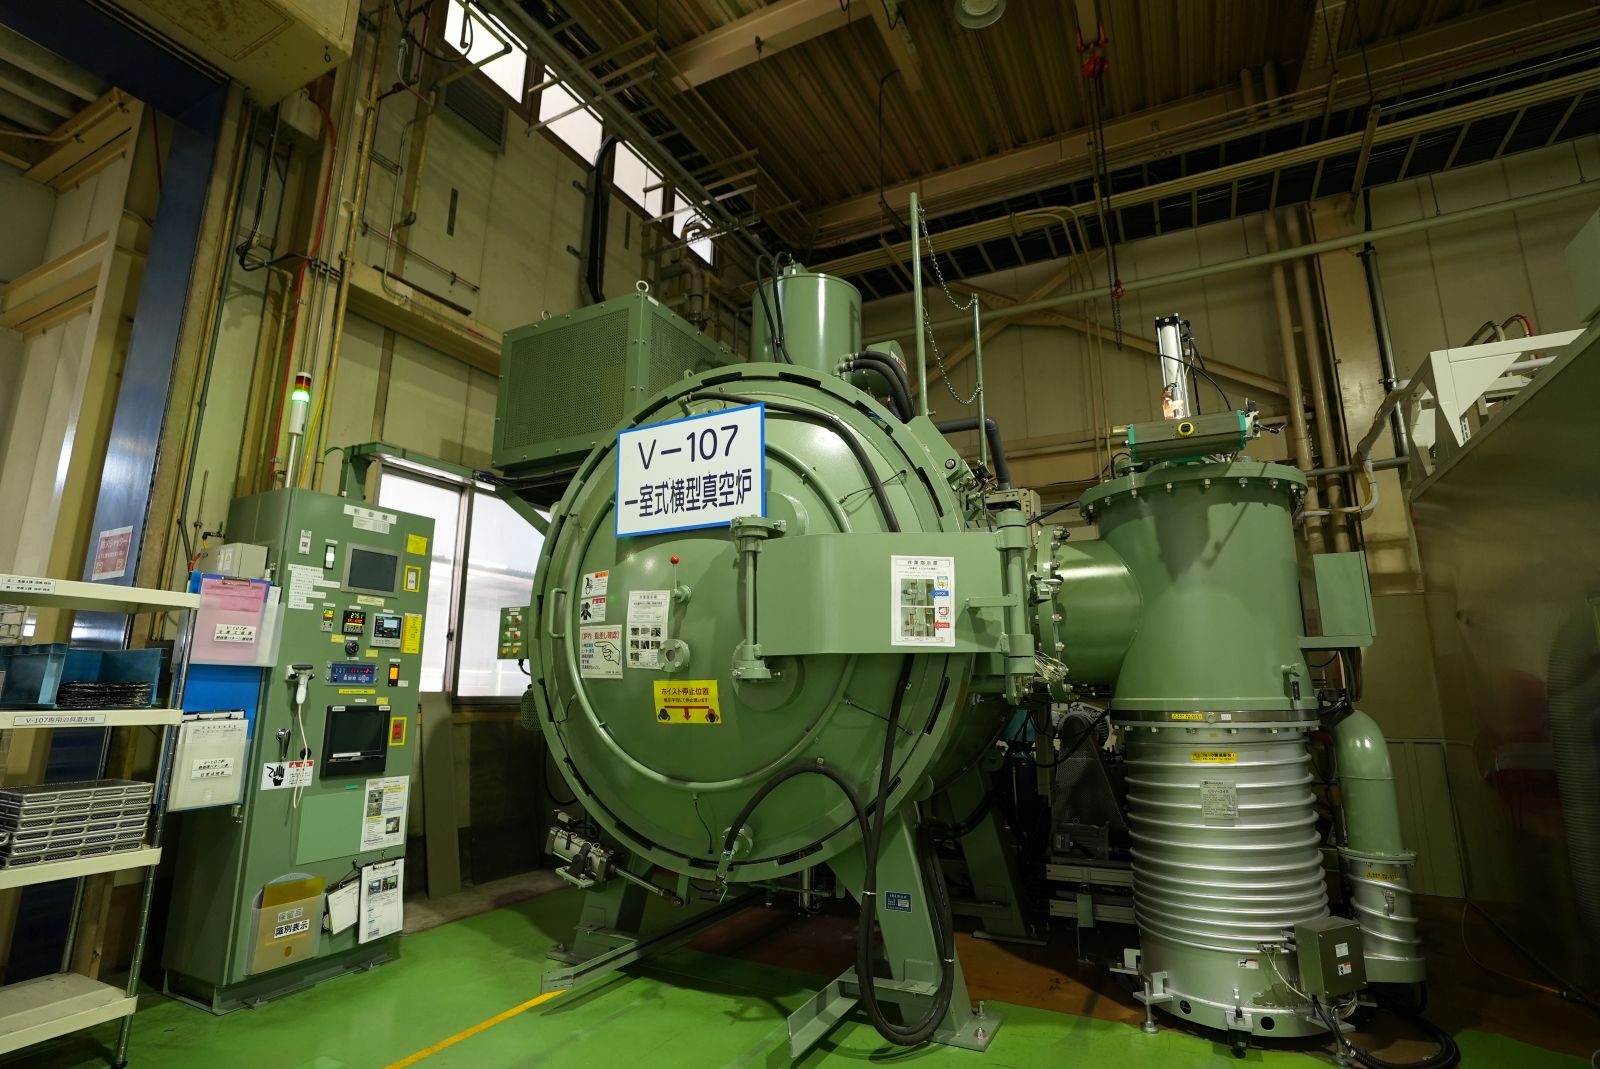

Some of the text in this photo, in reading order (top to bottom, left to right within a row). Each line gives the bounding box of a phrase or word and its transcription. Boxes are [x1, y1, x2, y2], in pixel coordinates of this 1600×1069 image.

[638, 424, 739, 470] V-107
[624, 468, 752, 517] 一室式横型真空炉
[661, 687, 709, 695] ホイスト停止位置
[275, 920, 308, 936] 識別表示
